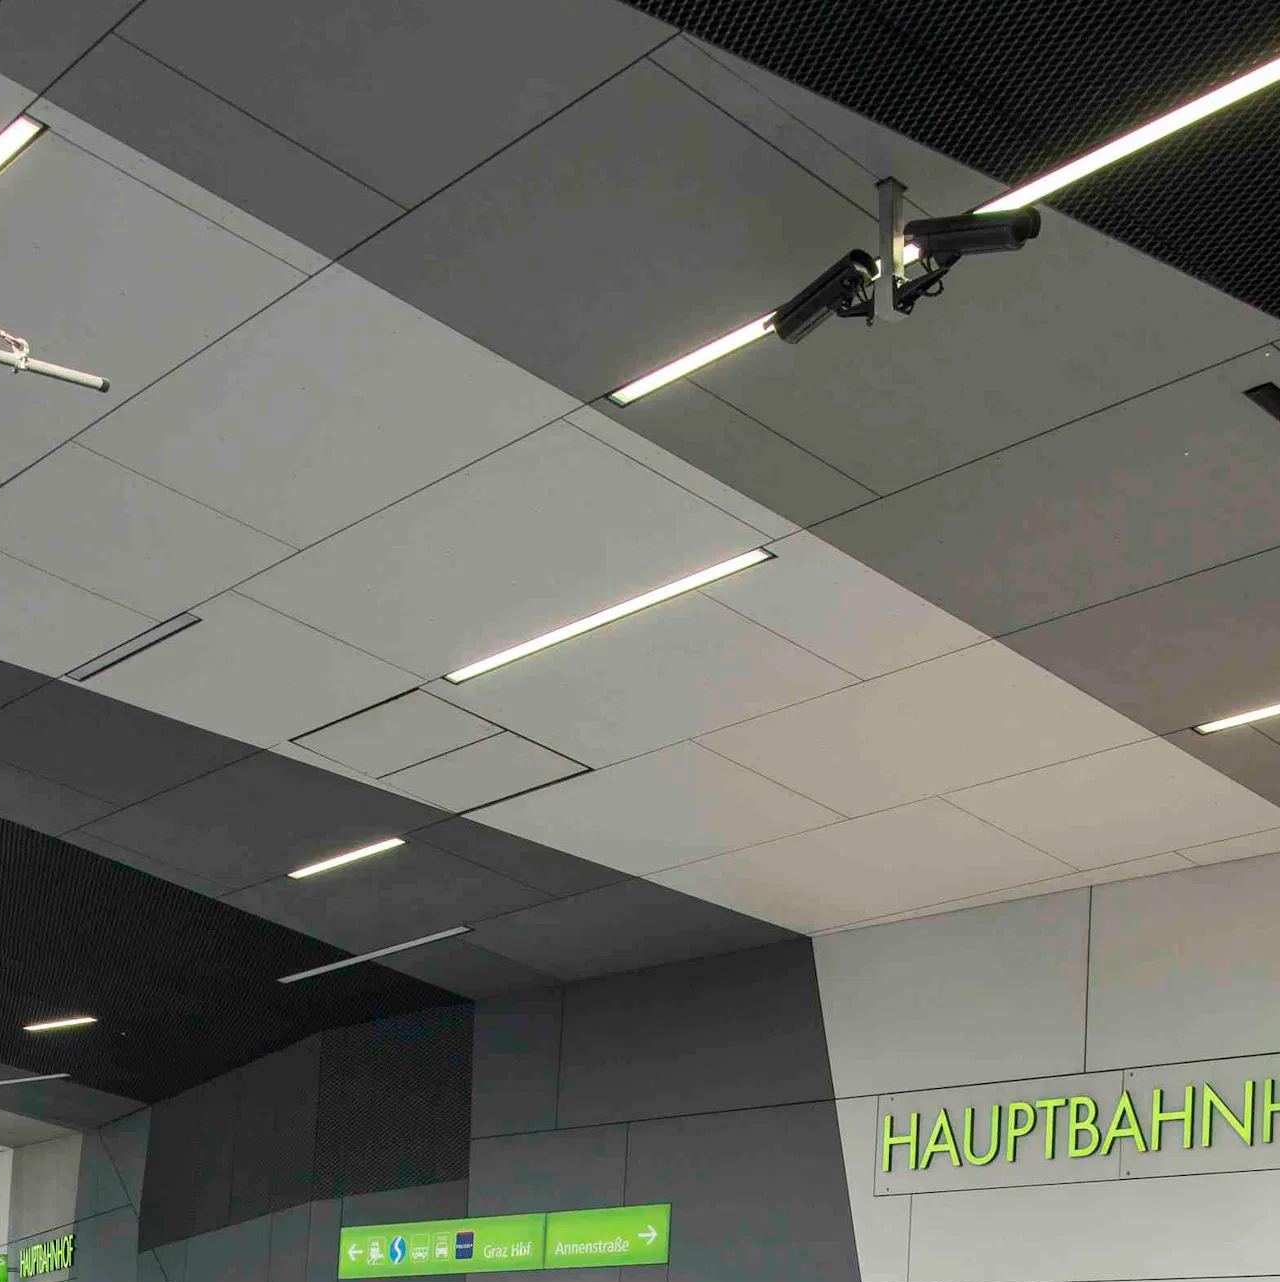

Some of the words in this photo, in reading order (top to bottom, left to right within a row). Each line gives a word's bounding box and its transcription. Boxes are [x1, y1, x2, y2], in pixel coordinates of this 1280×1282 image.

[19, 1234, 74, 1278] HAUPTBAHNHOF
[483, 1243, 508, 1259] Graz
[511, 1240, 533, 1257] Hbf.
[554, 1236, 630, 1256] Annenstraße
